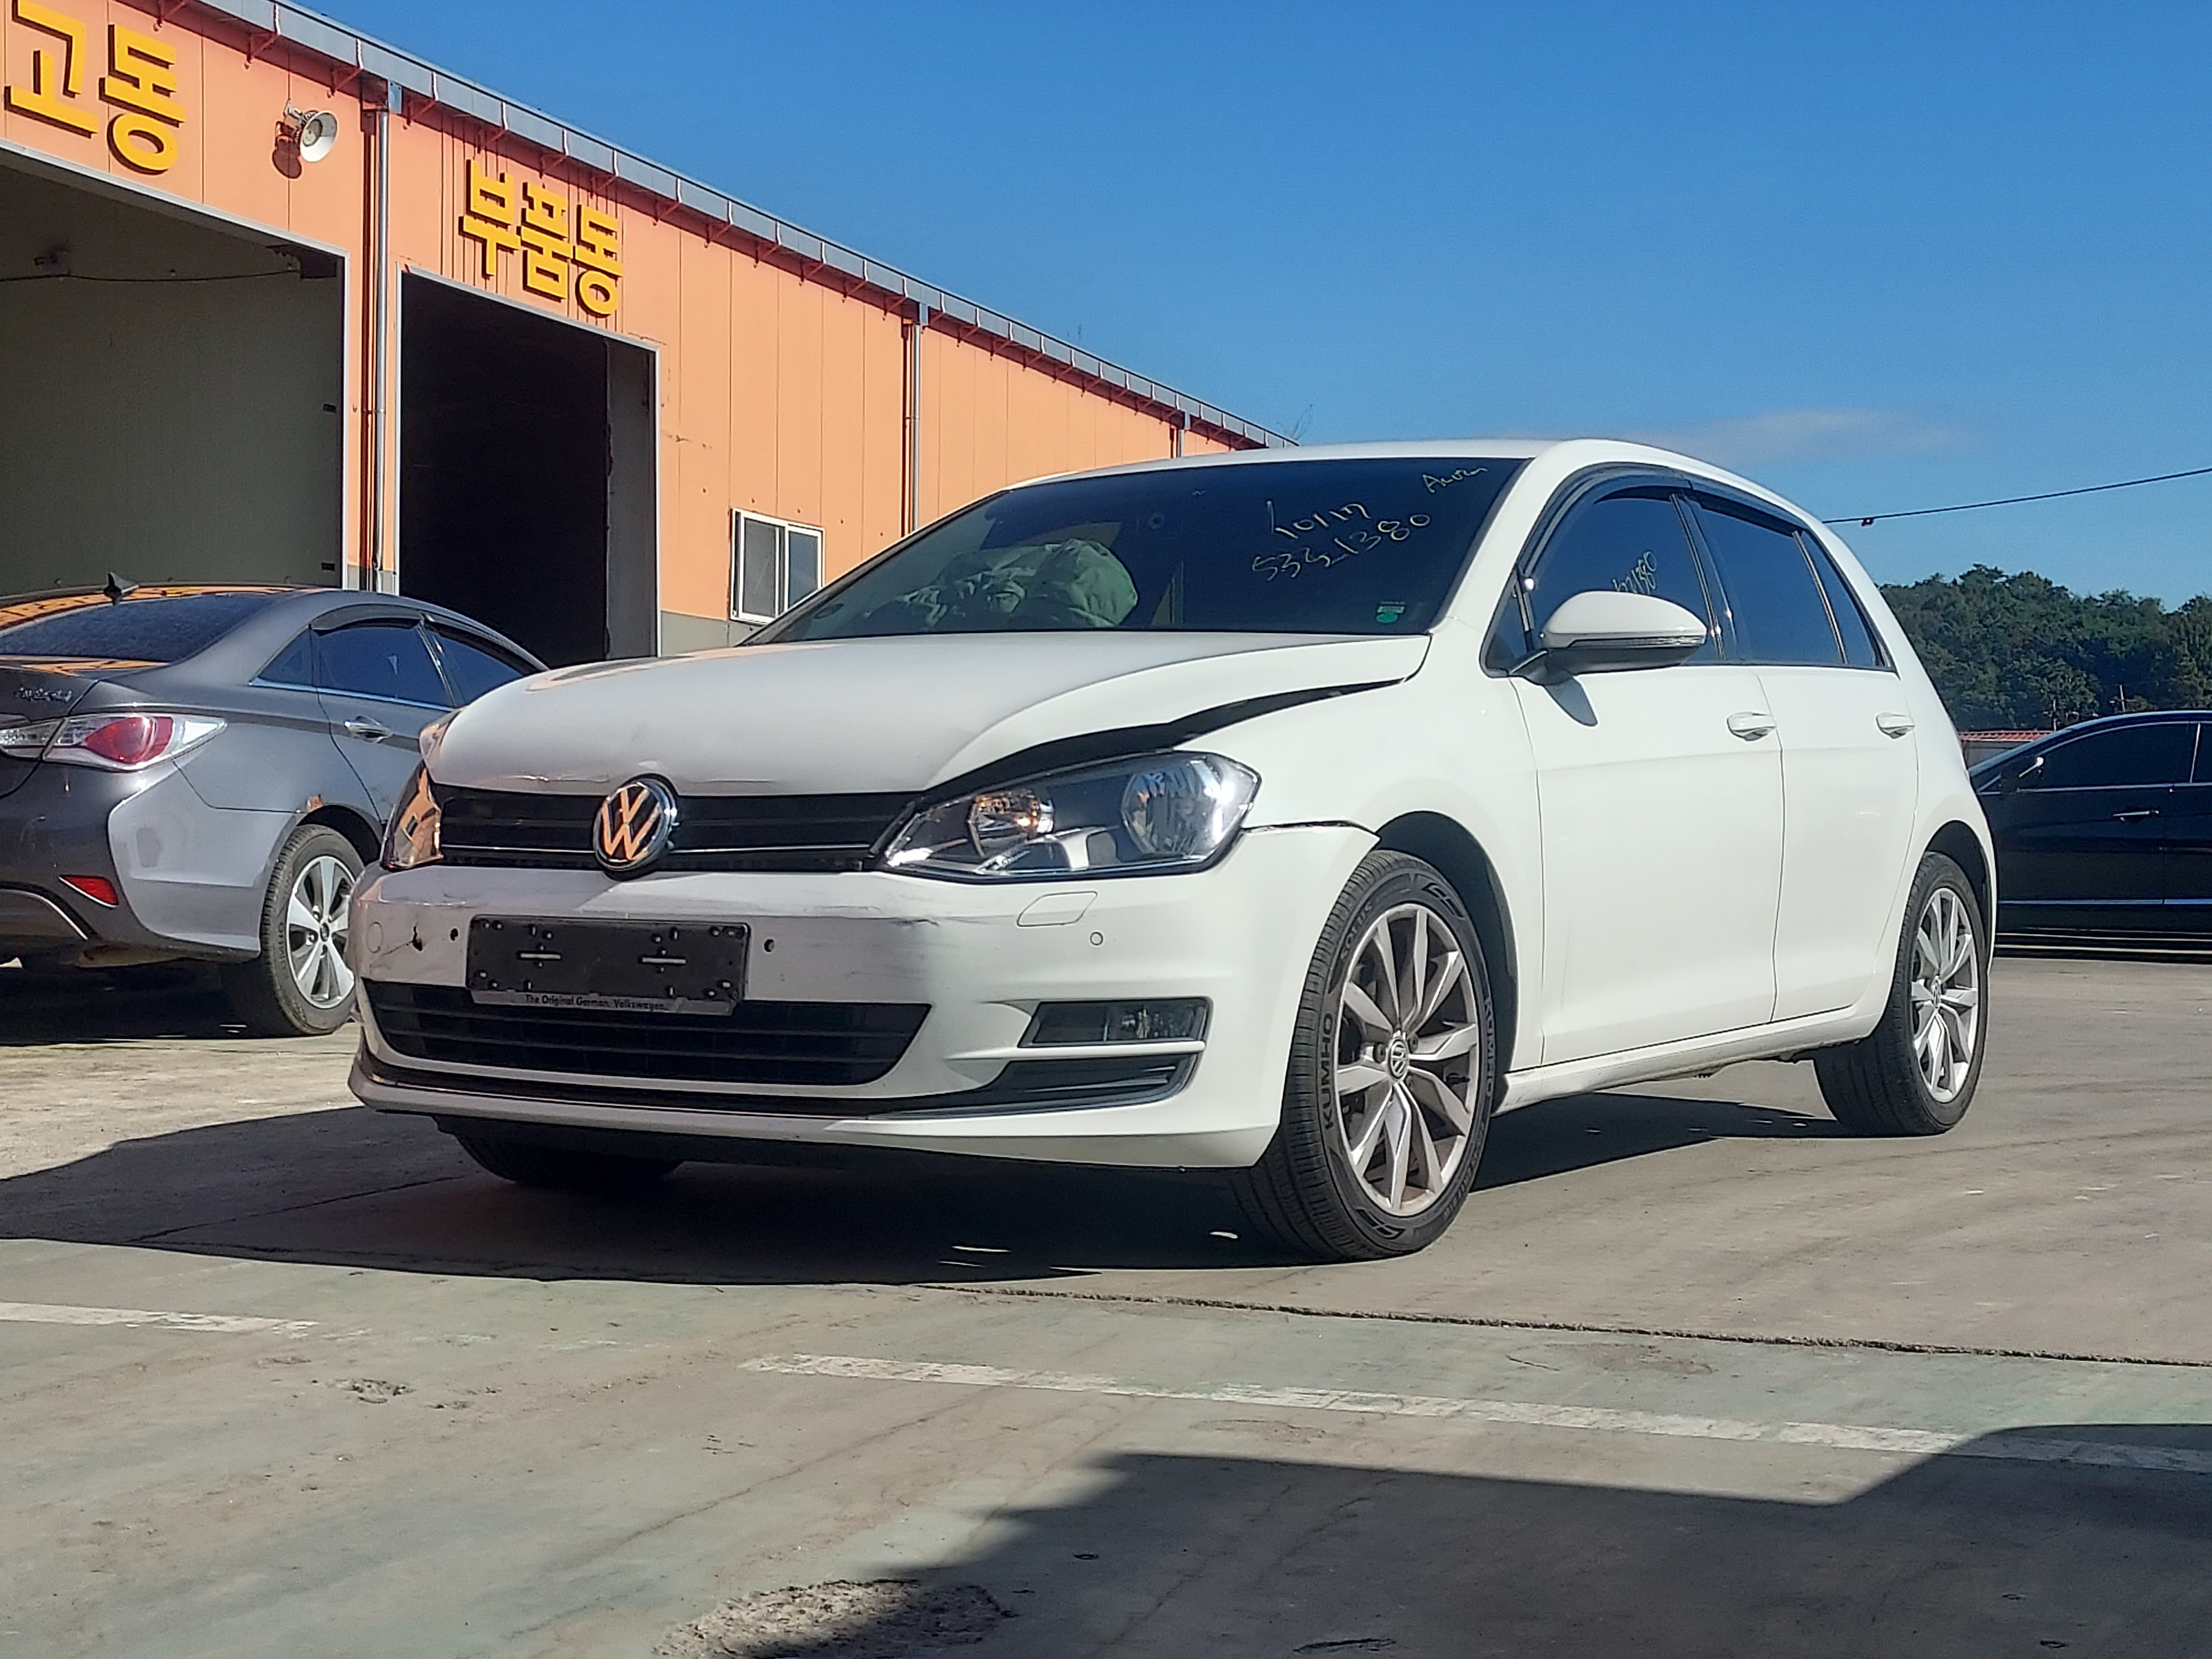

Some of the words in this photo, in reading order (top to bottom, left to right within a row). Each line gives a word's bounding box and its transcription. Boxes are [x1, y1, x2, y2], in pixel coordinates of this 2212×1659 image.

[459, 159, 624, 317] 부품동
[526, 995, 540, 1004] The
[541, 995, 574, 1007] Original
[1320, 1013, 1334, 1130] KUMHO
